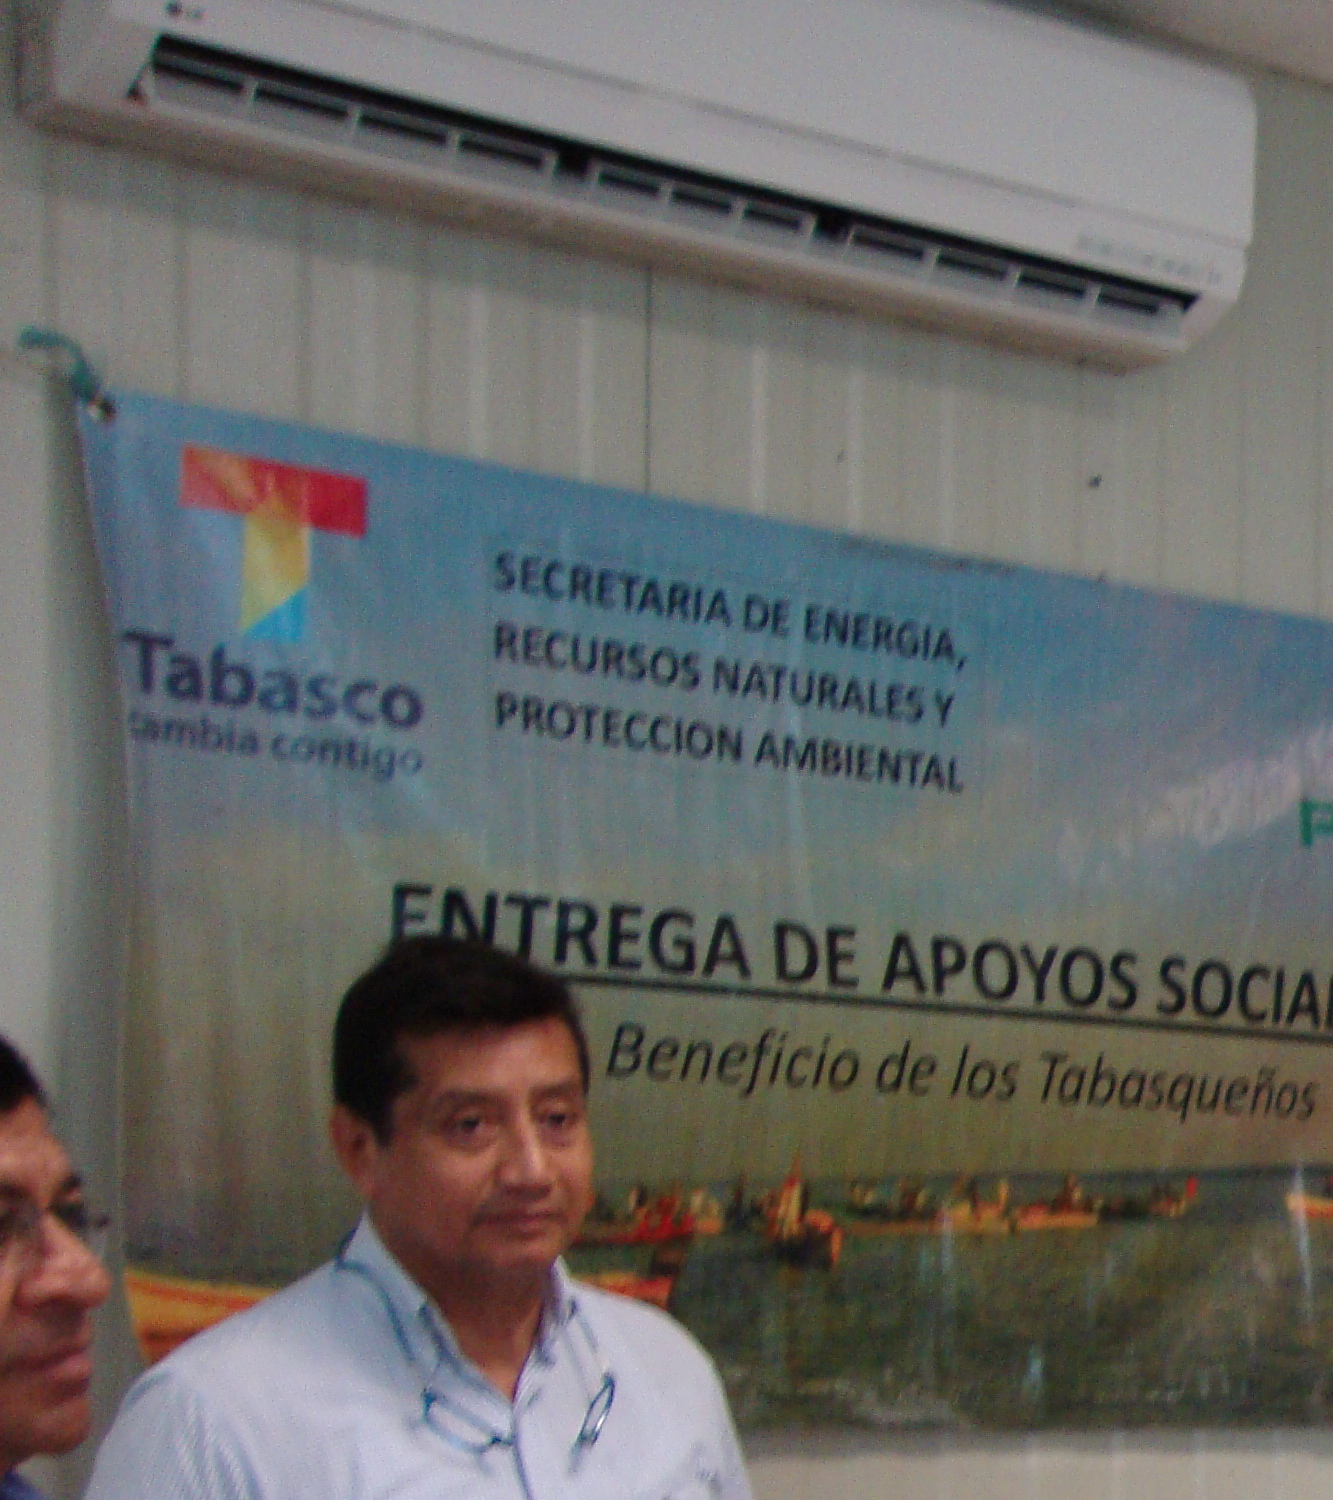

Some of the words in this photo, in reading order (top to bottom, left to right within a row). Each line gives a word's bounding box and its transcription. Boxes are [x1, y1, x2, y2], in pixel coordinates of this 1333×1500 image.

[494, 551, 732, 628] SECRETARIA
[742, 593, 791, 638] DE
[803, 603, 967, 673] ENERGIA,
[123, 628, 425, 732] Tabasco
[494, 620, 701, 691] RECURSOS
[712, 656, 924, 724] NATURALES
[933, 687, 956, 728] Y
[271, 732, 424, 782] contigo
[494, 691, 744, 763] PROTECCION
[754, 730, 964, 793] AMBIENTAL
[393, 882, 752, 980] ENTREGA
[773, 918, 860, 990] DE
[882, 931, 1138, 1012] APOYOS
[606, 1021, 860, 1097] Beneficio
[875, 1038, 936, 1097] de
[951, 1044, 1021, 1101] los
[1041, 1049, 1318, 1124] Tabasqueños
